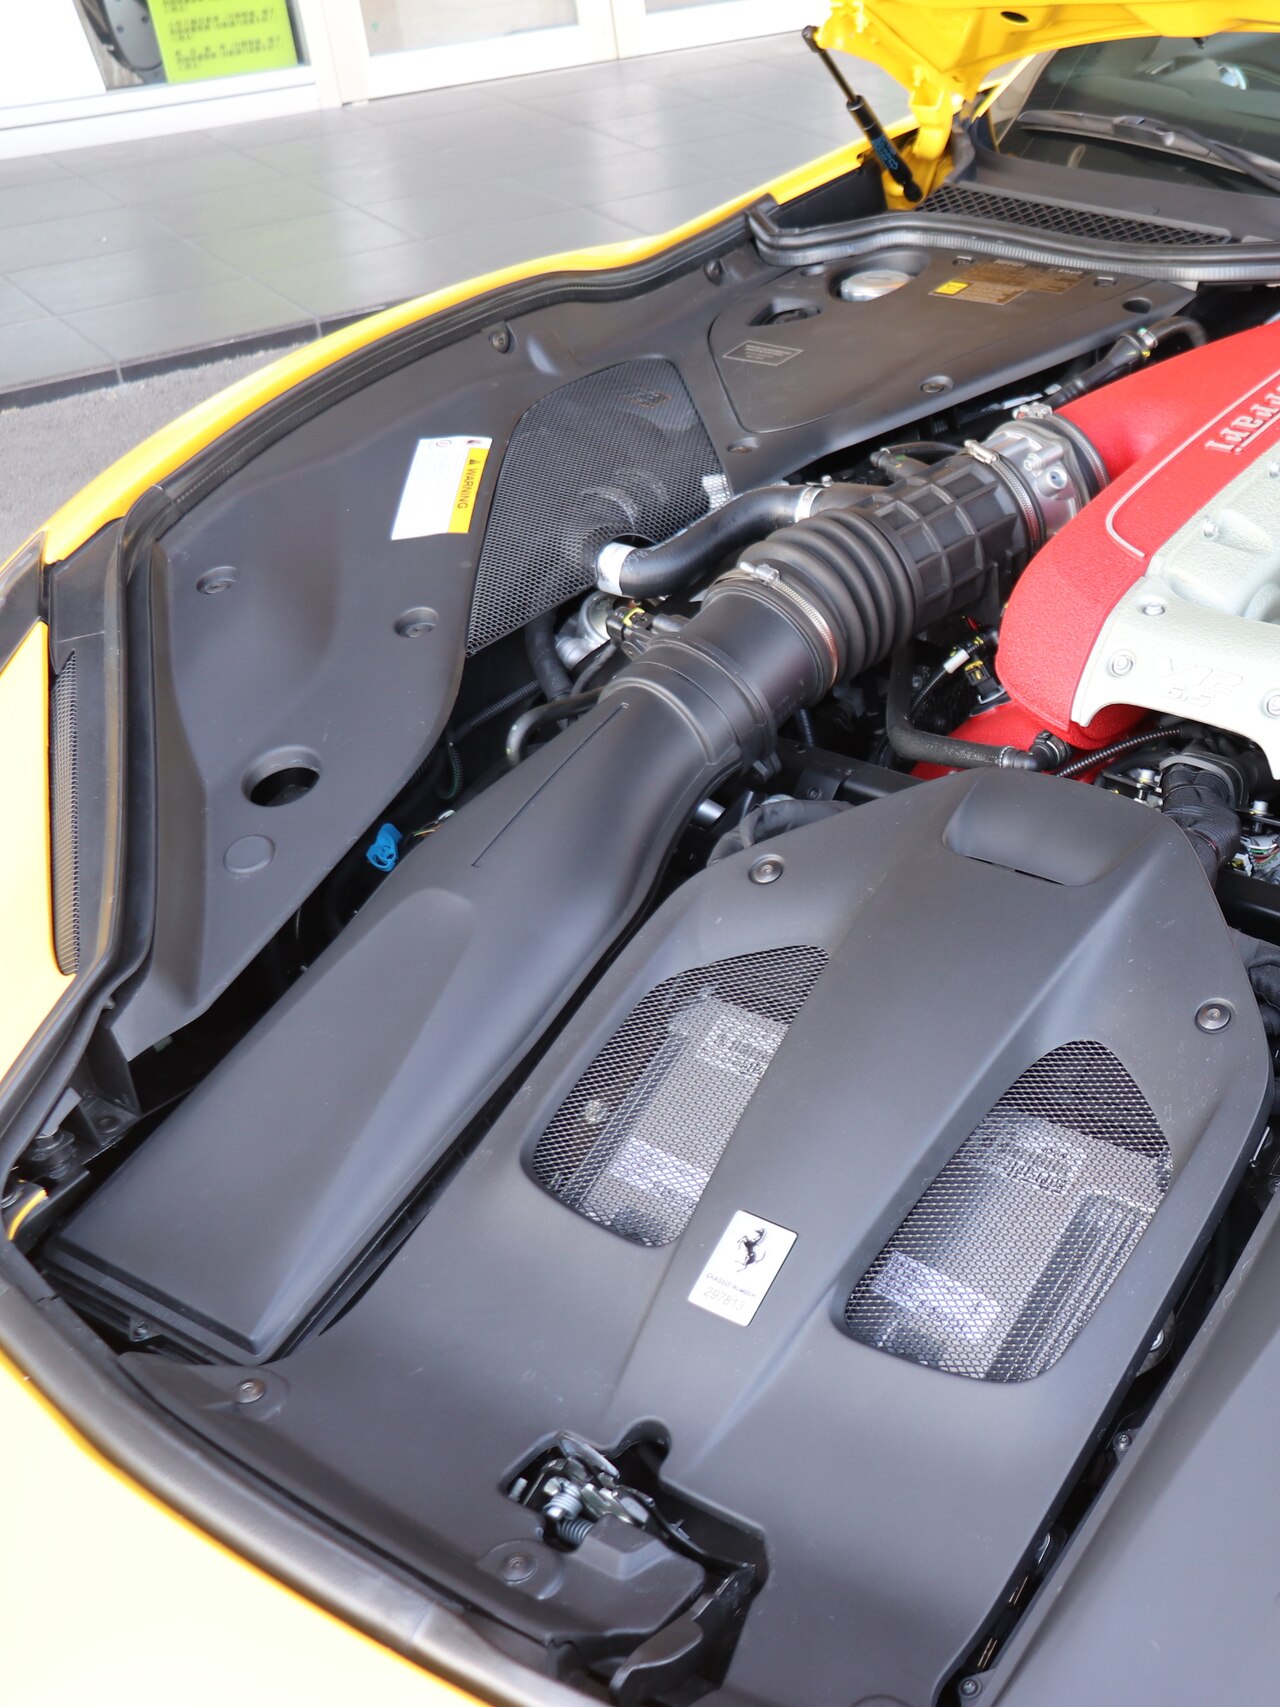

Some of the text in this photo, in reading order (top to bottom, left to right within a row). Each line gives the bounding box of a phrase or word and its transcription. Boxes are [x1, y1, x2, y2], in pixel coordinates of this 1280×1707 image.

[457, 469, 477, 509] WARNING
[706, 1273, 756, 1297] CHASSIS NUMBER
